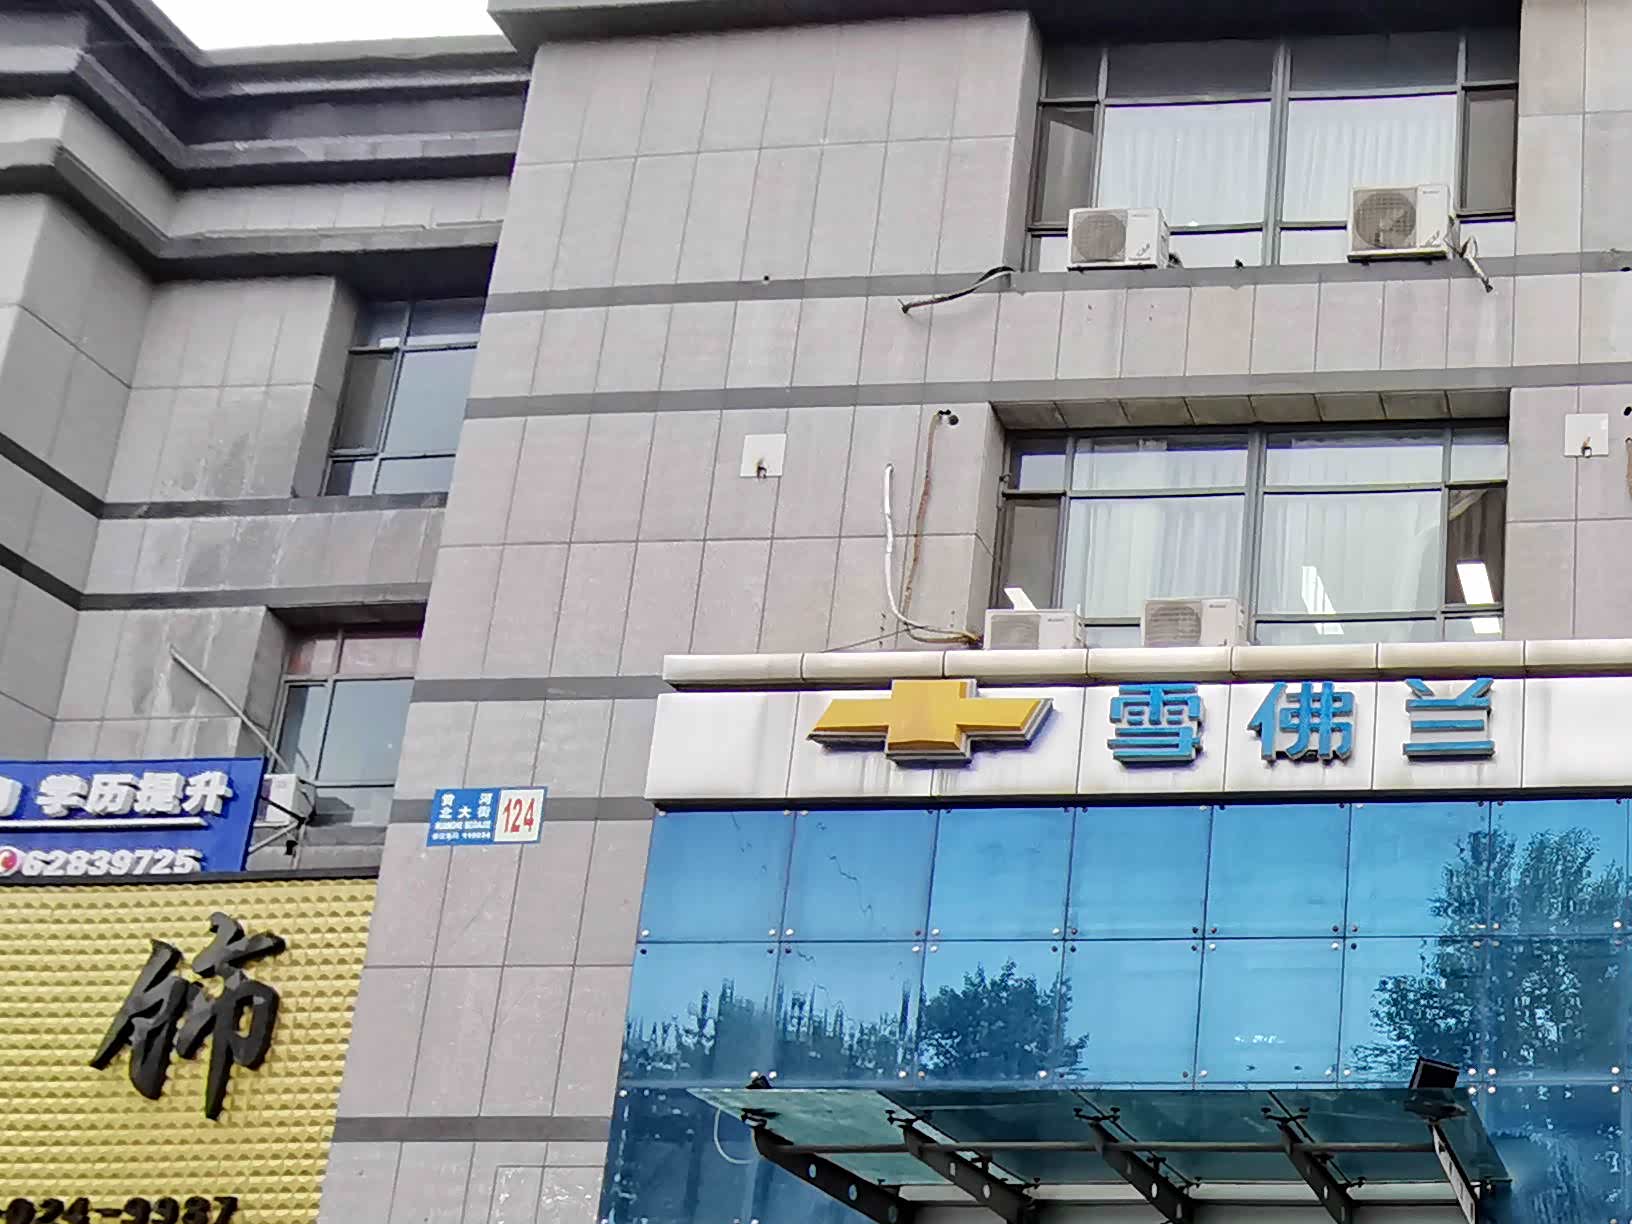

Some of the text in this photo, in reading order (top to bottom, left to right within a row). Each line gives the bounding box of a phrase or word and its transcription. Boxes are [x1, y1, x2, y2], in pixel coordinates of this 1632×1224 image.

[1107, 677, 1495, 766] 雪佛兰
[35, 770, 233, 818] 学历提升
[502, 798, 536, 833] 124
[22, 849, 201, 876] 62839725
